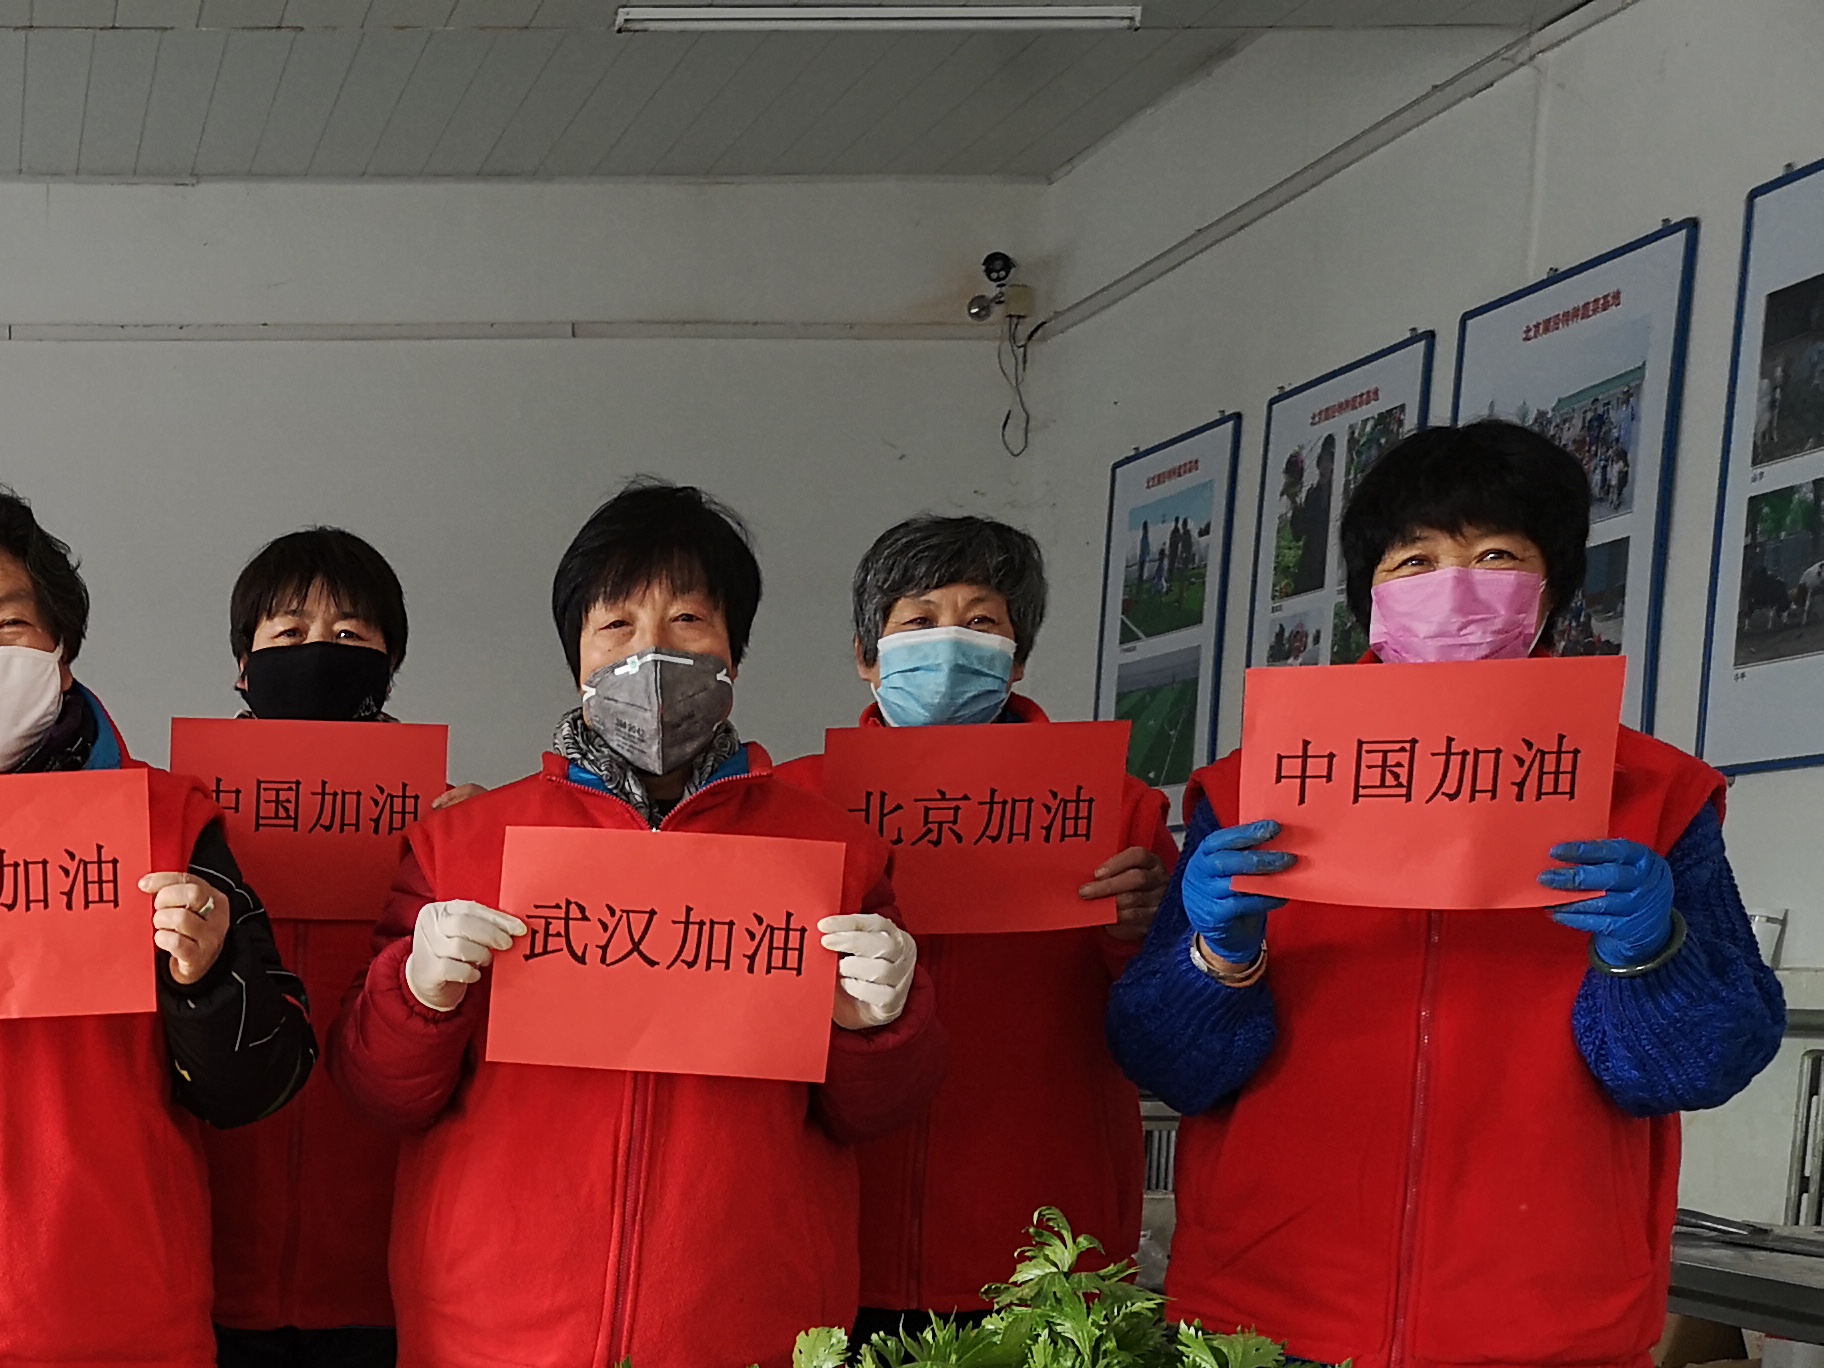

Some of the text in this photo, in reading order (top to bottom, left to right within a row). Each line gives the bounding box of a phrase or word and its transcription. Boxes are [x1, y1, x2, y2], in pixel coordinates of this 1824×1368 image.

[1274, 733, 1583, 807] 中国加油
[847, 784, 1096, 848] 北京加油
[522, 897, 809, 978] 武汉加油
